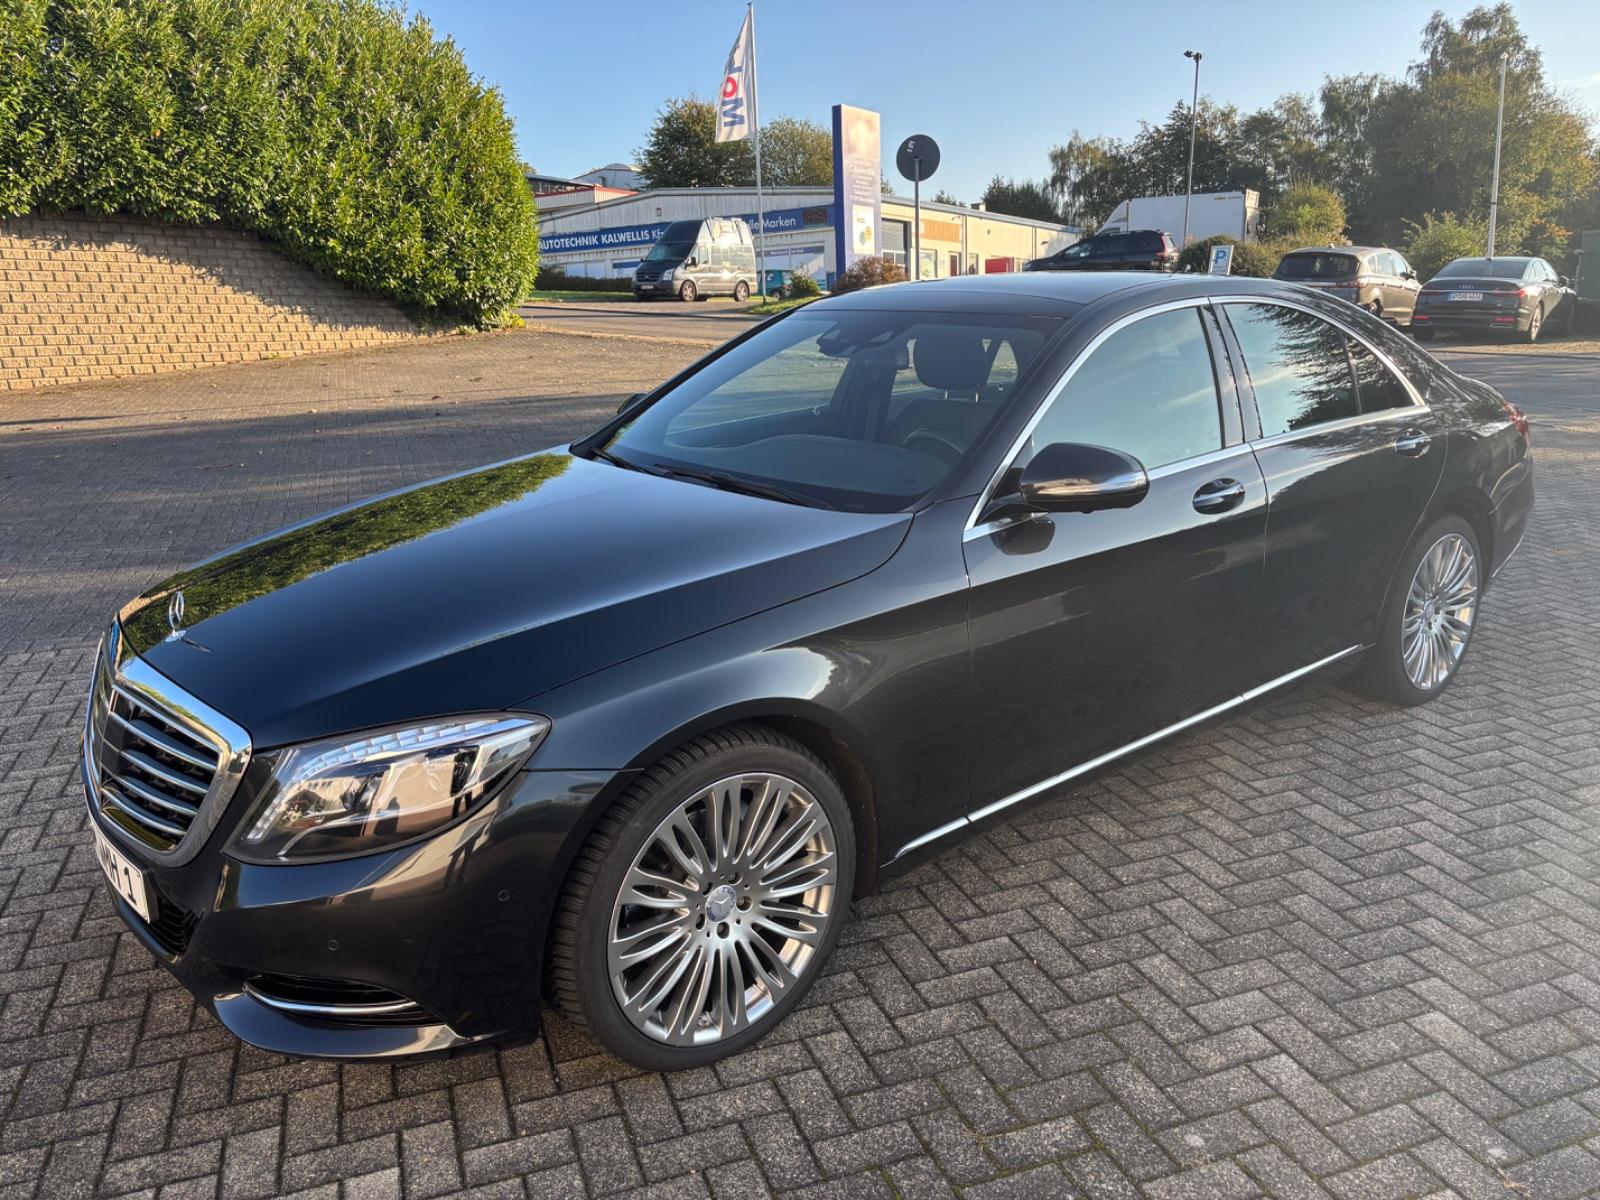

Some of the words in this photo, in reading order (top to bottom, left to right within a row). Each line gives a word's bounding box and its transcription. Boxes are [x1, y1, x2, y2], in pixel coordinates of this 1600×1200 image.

[762, 216, 796, 229] Marken
[538, 234, 599, 251] AUTOTECHNIK
[601, 230, 650, 244] KALWELLIS
[1215, 250, 1227, 264] P
